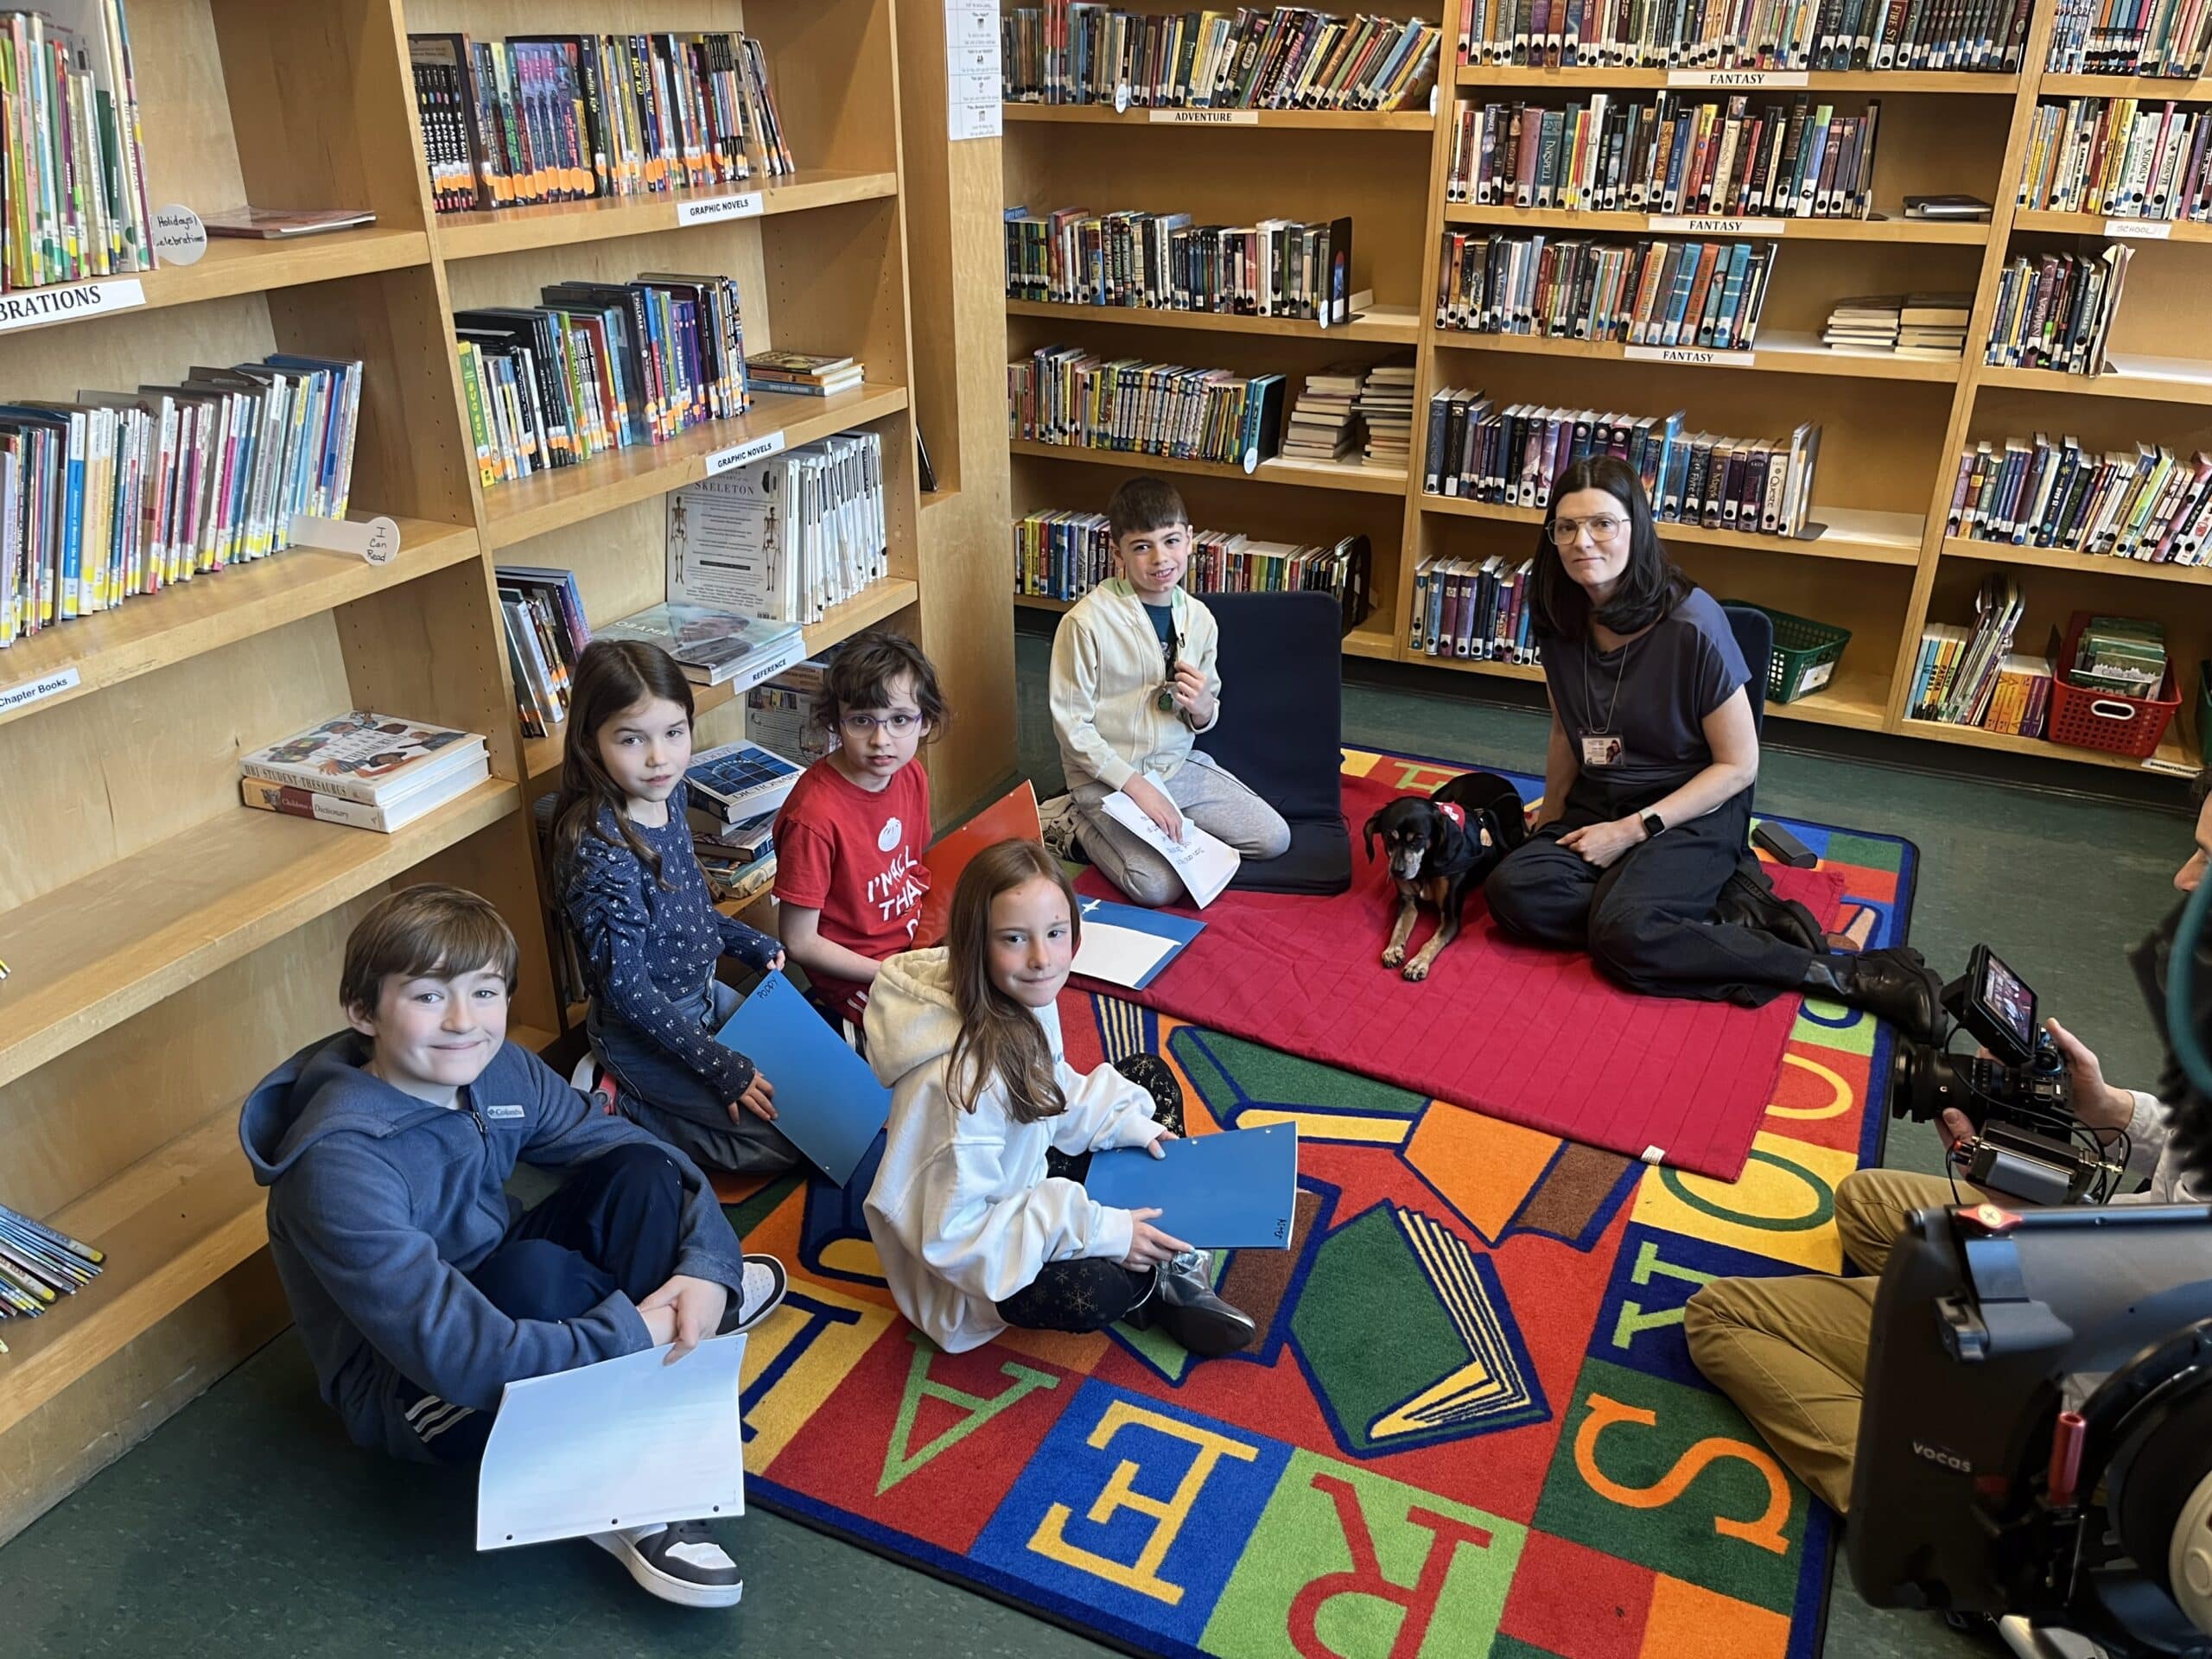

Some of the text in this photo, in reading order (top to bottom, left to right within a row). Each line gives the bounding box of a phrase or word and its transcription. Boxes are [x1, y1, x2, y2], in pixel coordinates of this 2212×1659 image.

[1888, 4, 1902, 29] FIRE
[642, 61, 652, 92] SCHOOL
[1710, 73, 1765, 85] FANTASY
[1174, 112, 1232, 122] ADVENTURE
[1656, 124, 1674, 181] SABOTAG
[690, 199, 749, 217] GRAPHIC NOVELS
[157, 215, 199, 231] Holidays/
[1689, 220, 1743, 232] FANTASY
[156, 235, 206, 247] elebrations
[1662, 350, 1714, 363] FANTASY
[467, 382, 480, 412] BUG
[717, 442, 772, 468] GRAPHIC NOVELS
[695, 480, 755, 496] SKELETON
[1708, 472, 1722, 499] Magyk
[1767, 475, 1780, 509] Queste
[376, 527, 387, 538] I
[369, 538, 387, 549] Can
[367, 550, 386, 563] Read
[616, 620, 669, 637] OBAMA
[753, 658, 787, 682] REFERENCE
[0, 677, 68, 708] Chapter Books
[263, 767, 297, 787] STUDENT
[302, 777, 346, 796] THESAURUS
[314, 804, 349, 818] Dictionary
[1910, 1438, 1974, 1473] vocas
